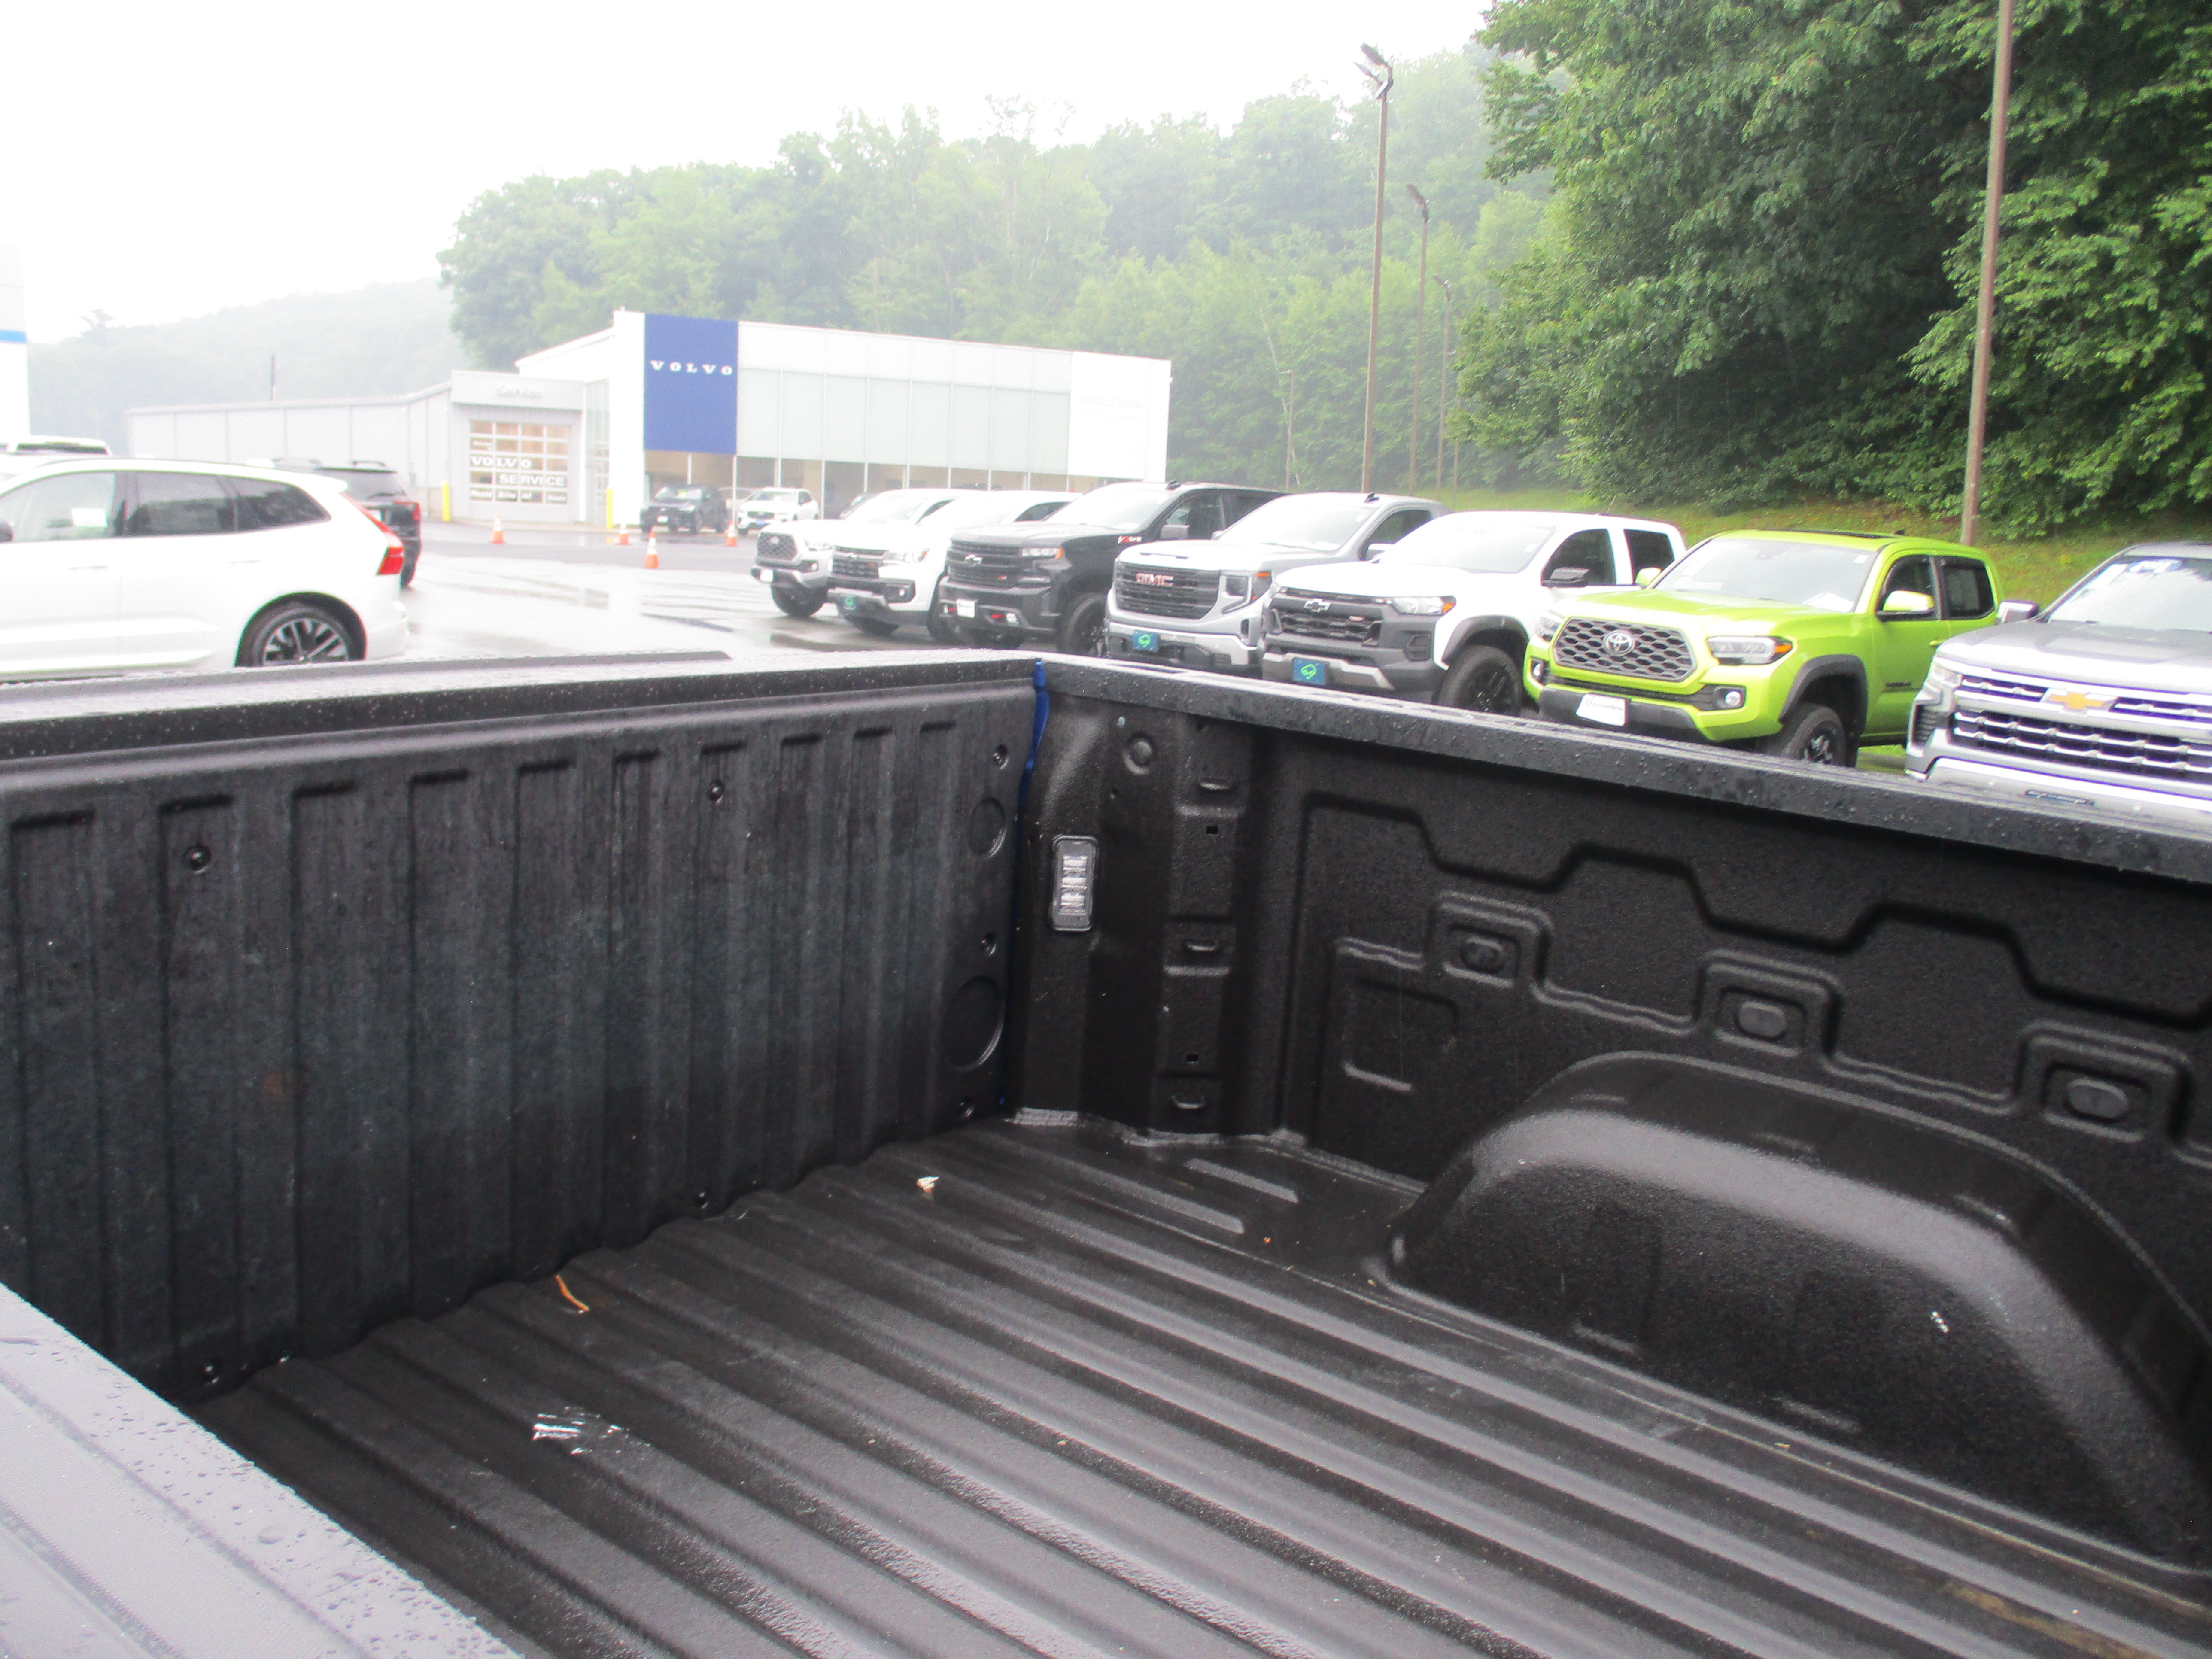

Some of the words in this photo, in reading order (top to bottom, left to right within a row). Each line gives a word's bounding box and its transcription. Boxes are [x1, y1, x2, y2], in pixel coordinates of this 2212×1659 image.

[650, 360, 733, 375] VOLVO
[471, 456, 532, 468] VOLVO
[500, 474, 566, 486] SERVICE
[1136, 573, 1174, 586] GMC
